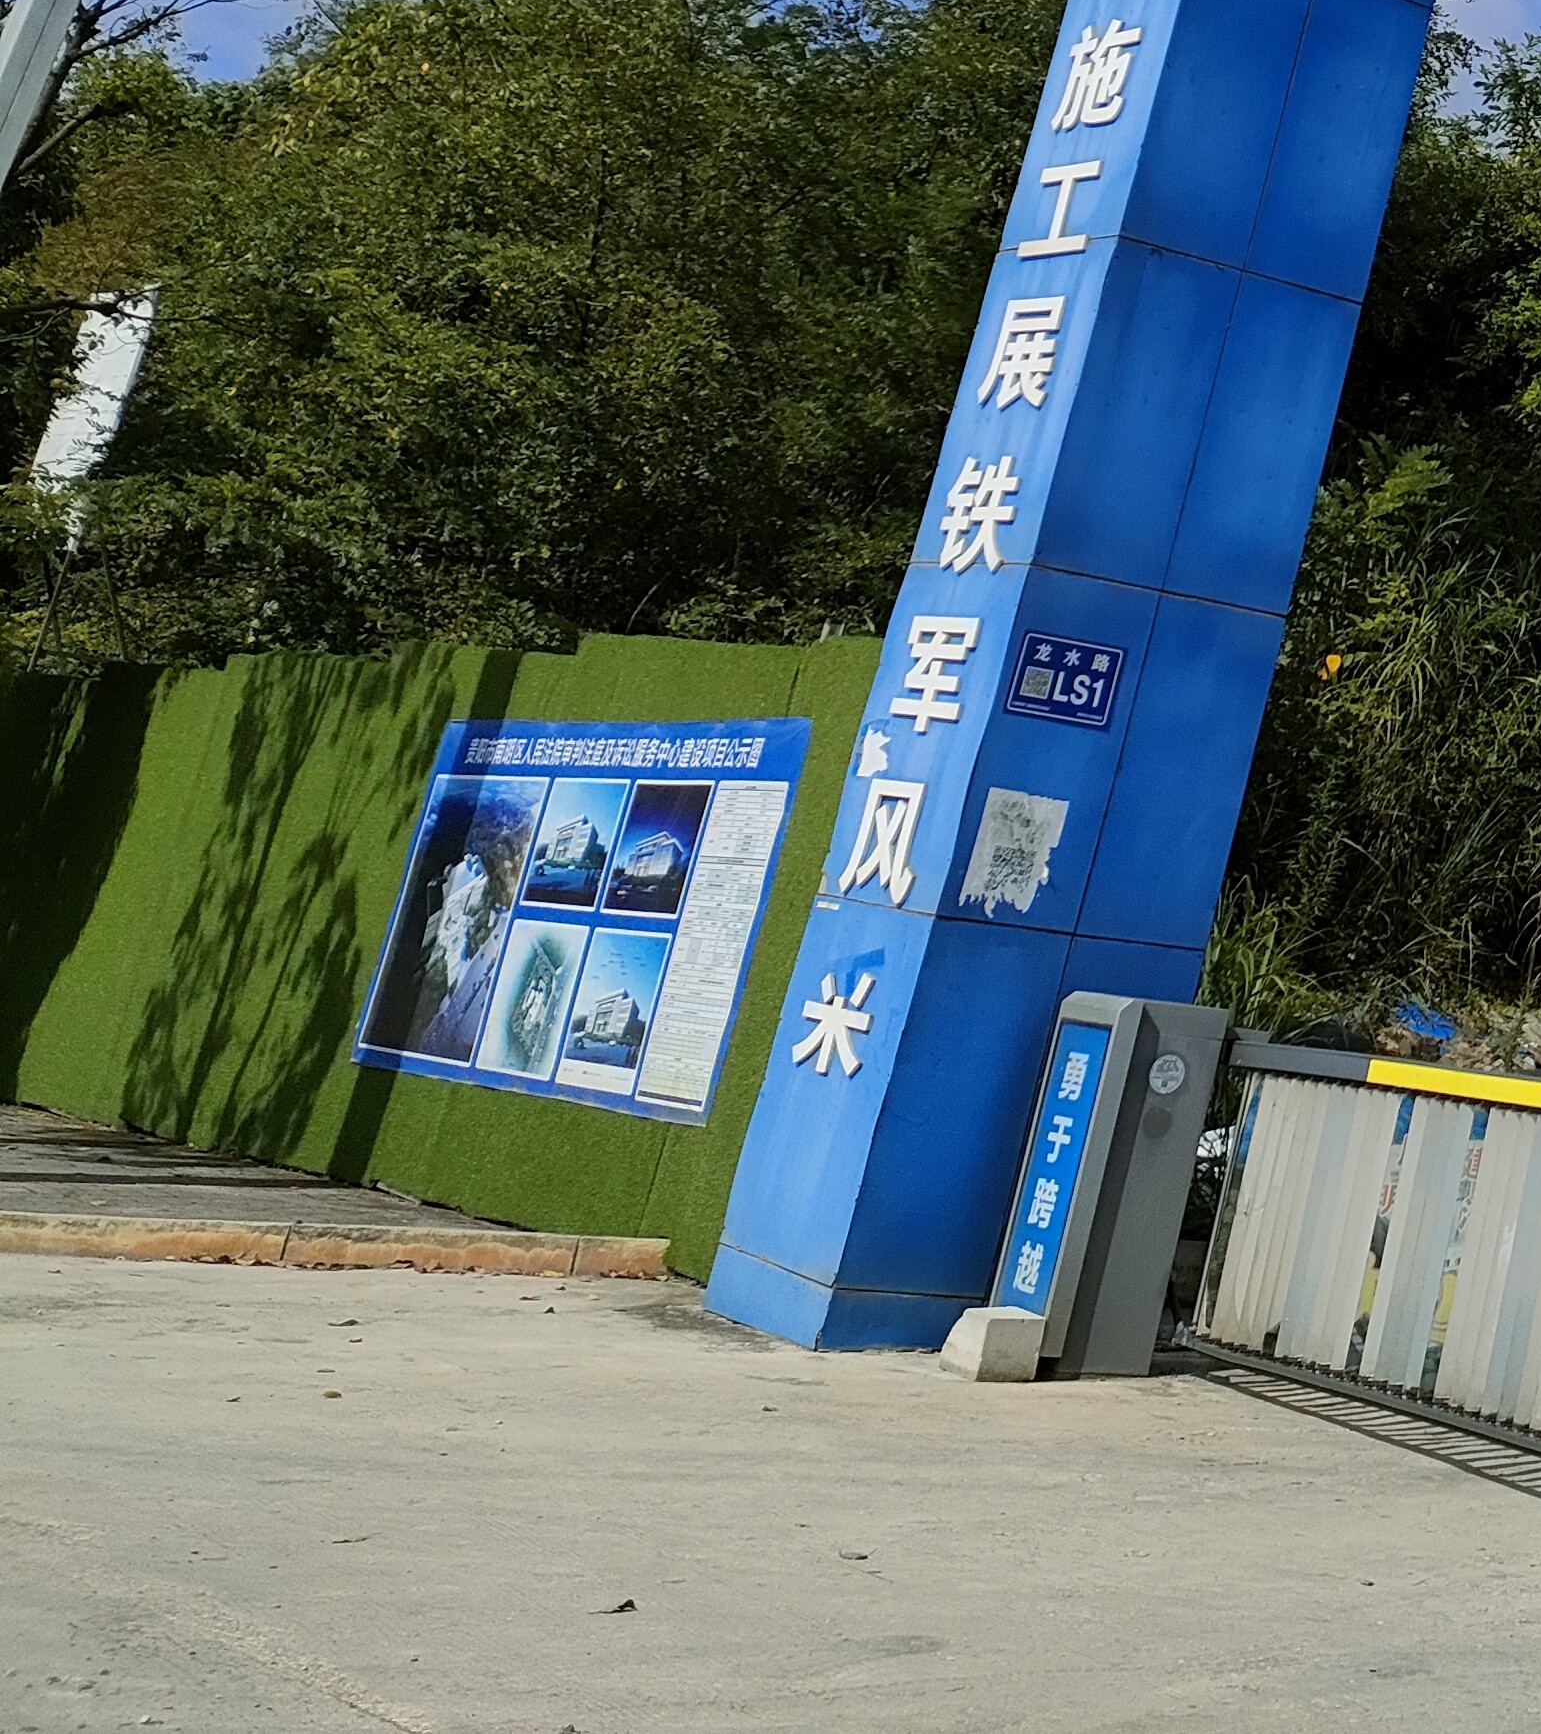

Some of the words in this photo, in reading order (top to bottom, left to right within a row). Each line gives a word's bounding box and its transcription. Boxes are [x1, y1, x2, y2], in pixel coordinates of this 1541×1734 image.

[1033, 642, 1111, 673] 龙水路
[1052, 670, 1107, 708] LS1
[1012, 1051, 1091, 1295] 勇于跨越
